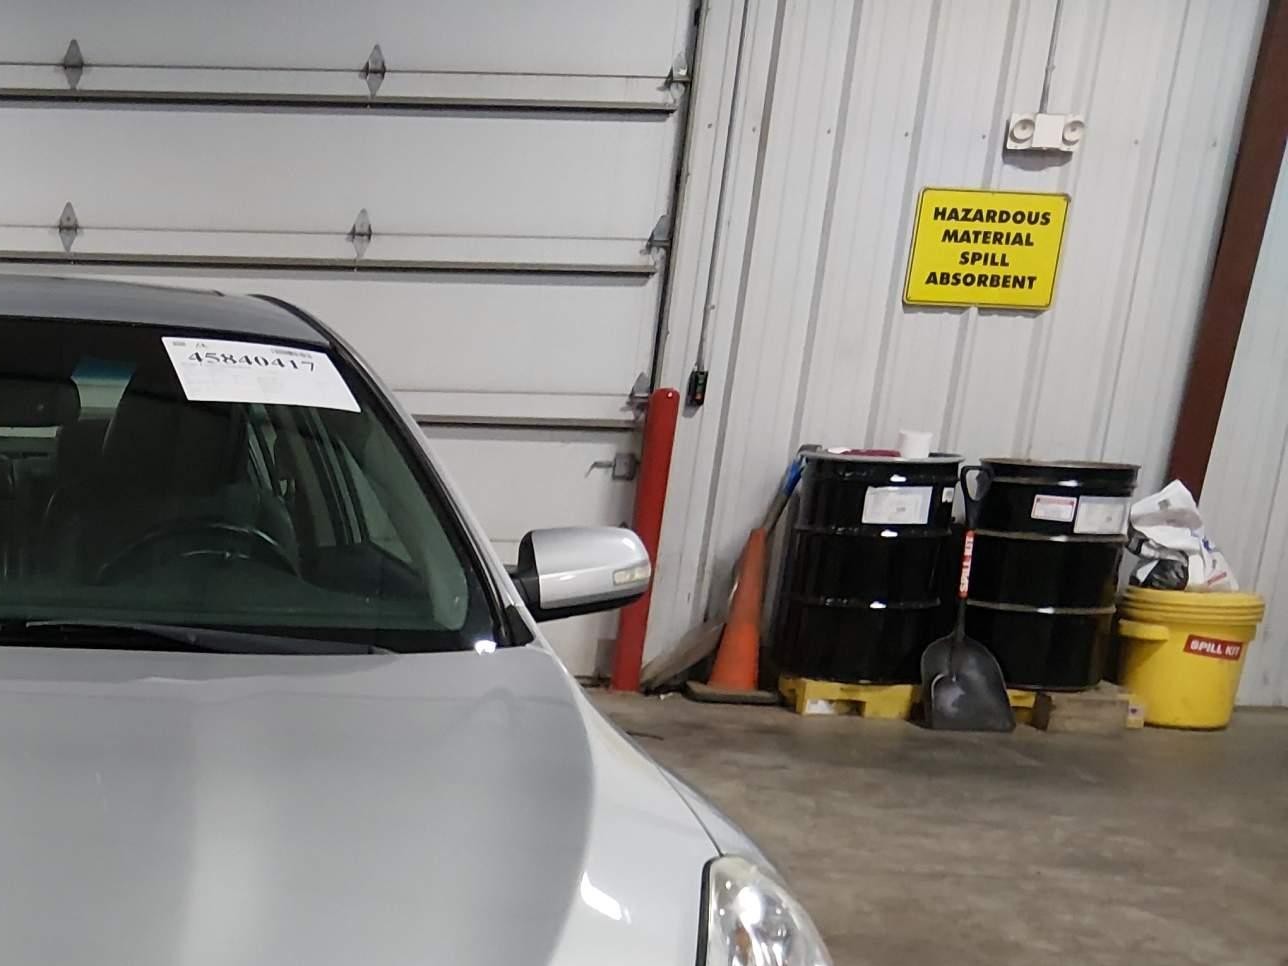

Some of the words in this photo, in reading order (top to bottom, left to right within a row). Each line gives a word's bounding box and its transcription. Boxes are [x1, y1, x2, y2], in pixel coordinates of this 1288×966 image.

[933, 207, 1051, 226] HAZARDOUS
[941, 229, 1034, 247] MATERIAL
[959, 251, 1010, 267] SPILL
[925, 271, 1037, 290] ABSORBENT
[188, 351, 315, 372] 45840417
[1190, 639, 1223, 655] SPILL
[1225, 645, 1241, 657] KIT
